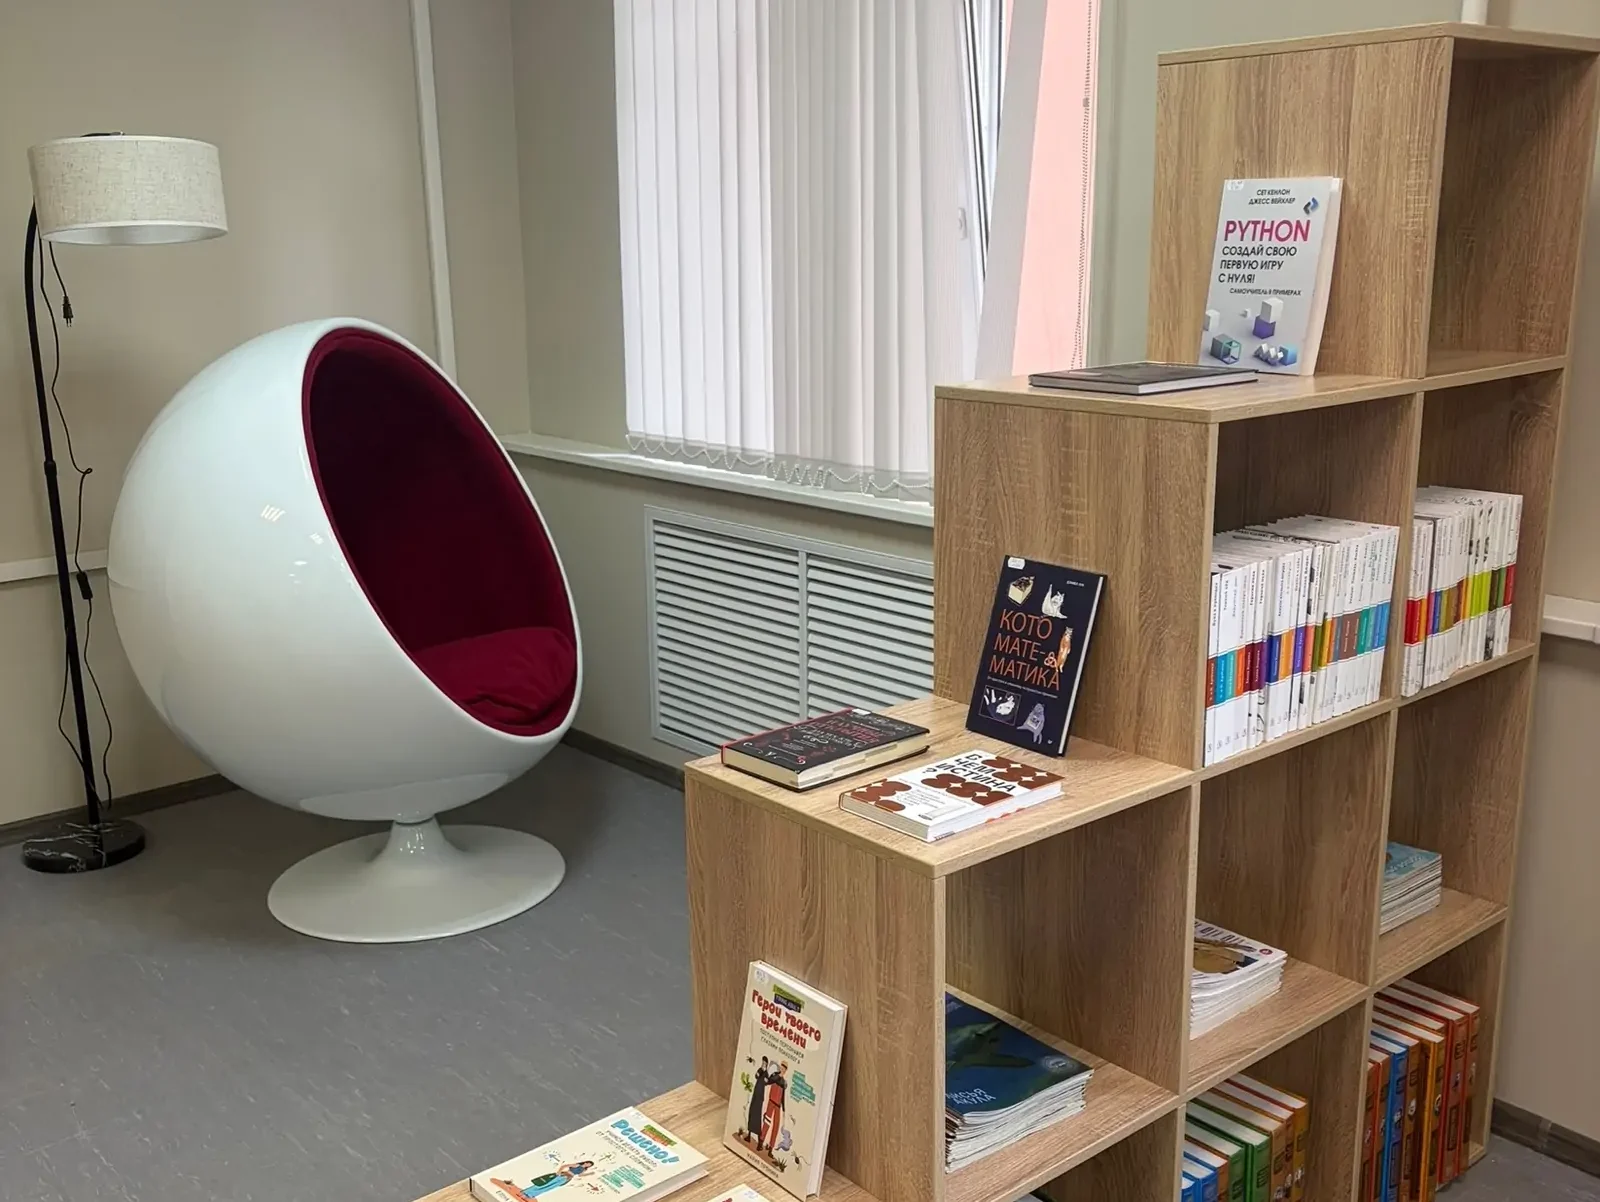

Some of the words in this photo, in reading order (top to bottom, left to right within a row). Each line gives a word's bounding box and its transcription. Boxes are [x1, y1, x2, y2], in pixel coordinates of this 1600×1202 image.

[1224, 219, 1311, 242] PYTHON
[1222, 244, 1264, 257] СОЗДАЙ
[1265, 246, 1297, 256] СВОЮ
[1220, 259, 1259, 270] ПЕРВУЮ
[1260, 260, 1284, 270] ИГРУ
[1218, 273, 1226, 283] С
[1227, 273, 1255, 284] НУЛЯ!
[1229, 287, 1267, 296] САМОУЧИТЕЛЬ
[1272, 288, 1301, 297] ПРИМЕРАХ
[1000, 609, 1053, 640] КОТО
[994, 633, 1046, 661] МАТЕ-
[989, 655, 1060, 691] МАТИКА
[955, 758, 996, 775] ЧЕМ
[935, 762, 1017, 793] ИСТИНА
